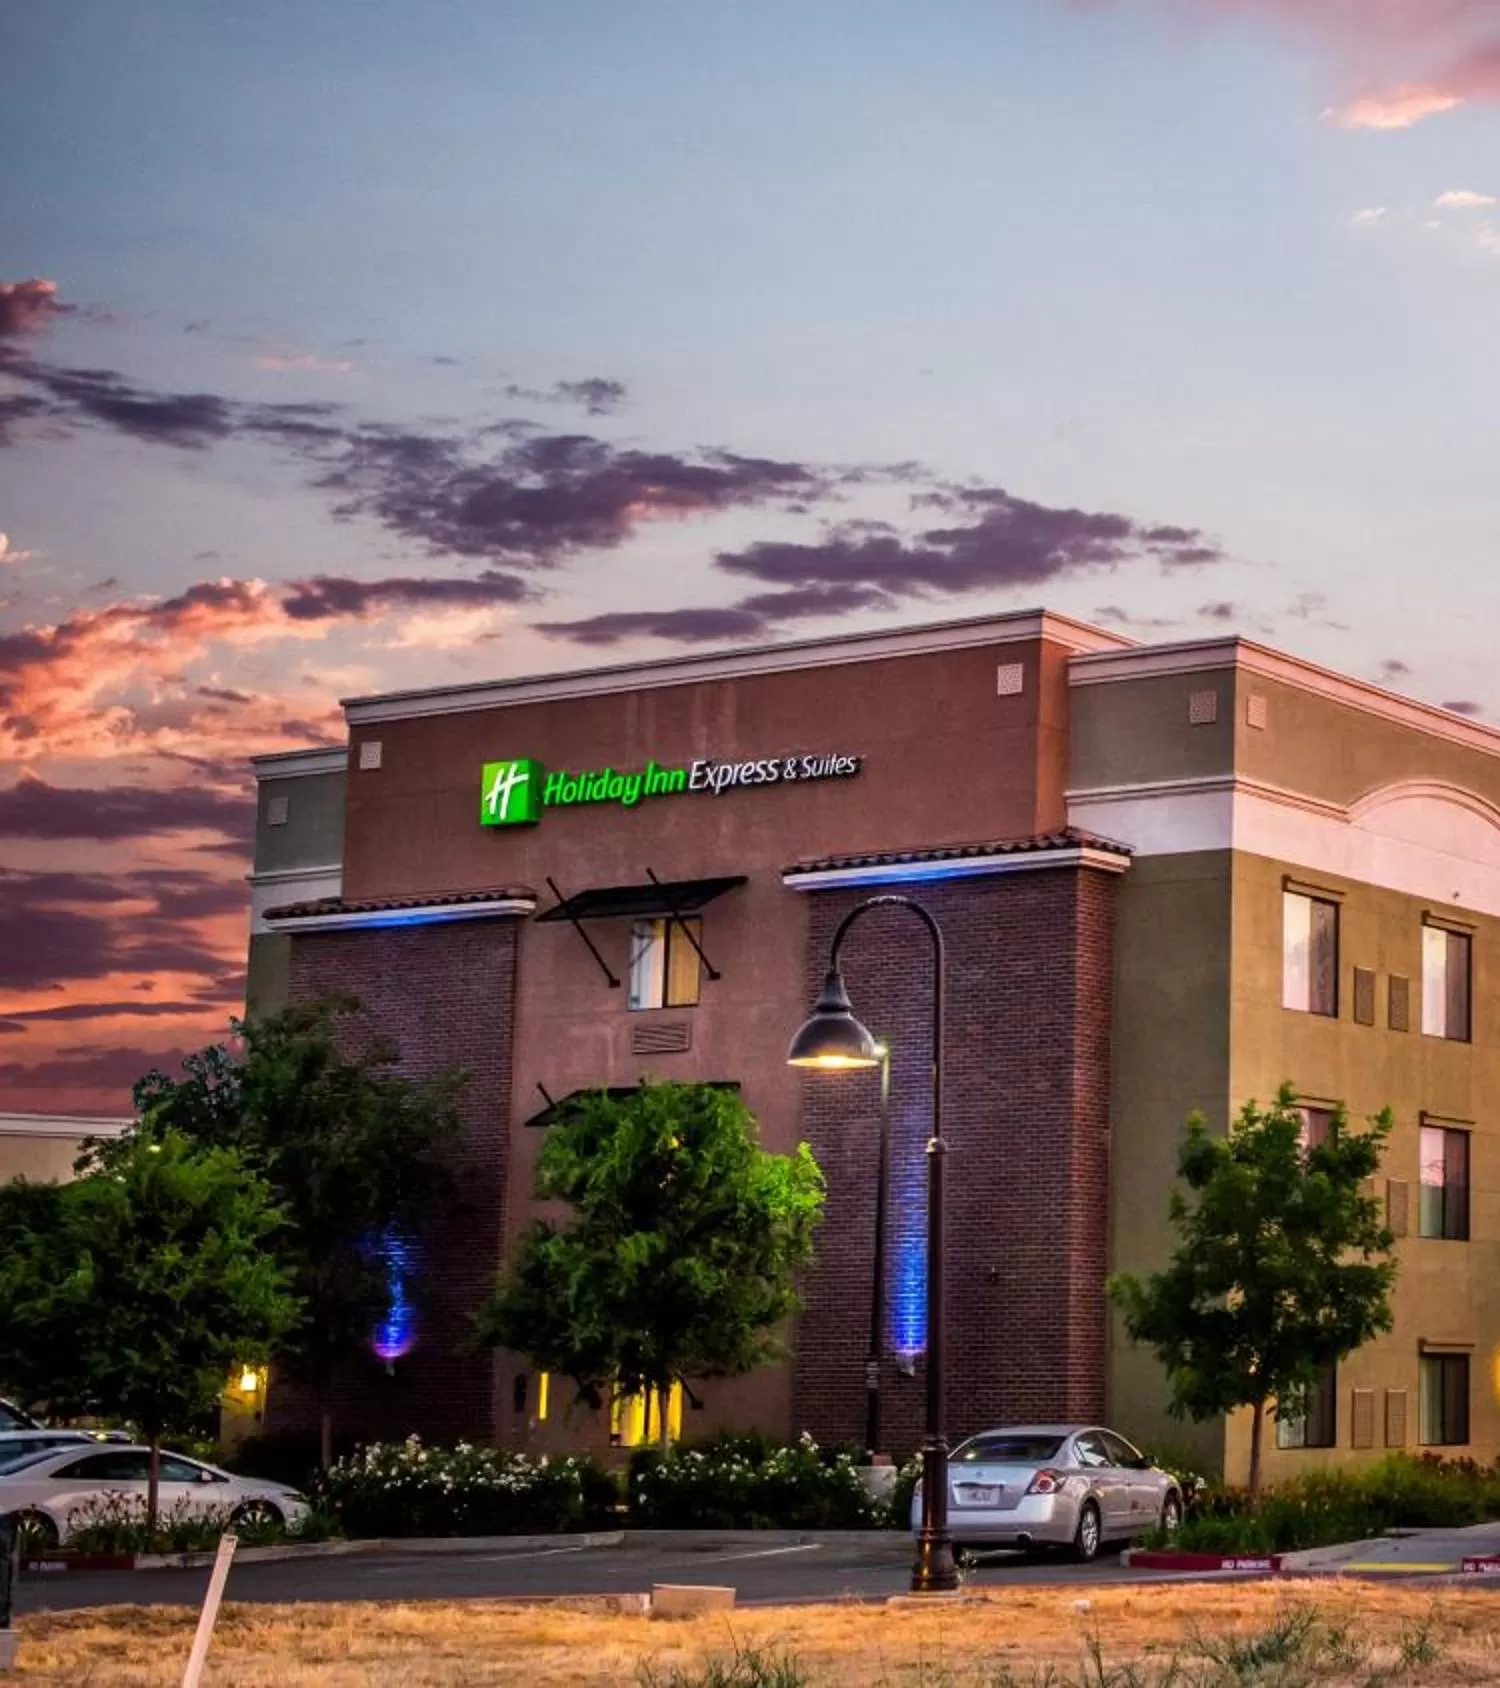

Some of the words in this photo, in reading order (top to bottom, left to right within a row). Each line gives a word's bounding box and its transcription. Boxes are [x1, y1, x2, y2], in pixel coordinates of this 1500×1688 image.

[543, 767, 641, 805] Holiday
[644, 760, 686, 795] Inn
[689, 759, 779, 794] Express
[783, 757, 796, 779] &
[800, 753, 857, 778] Suites
